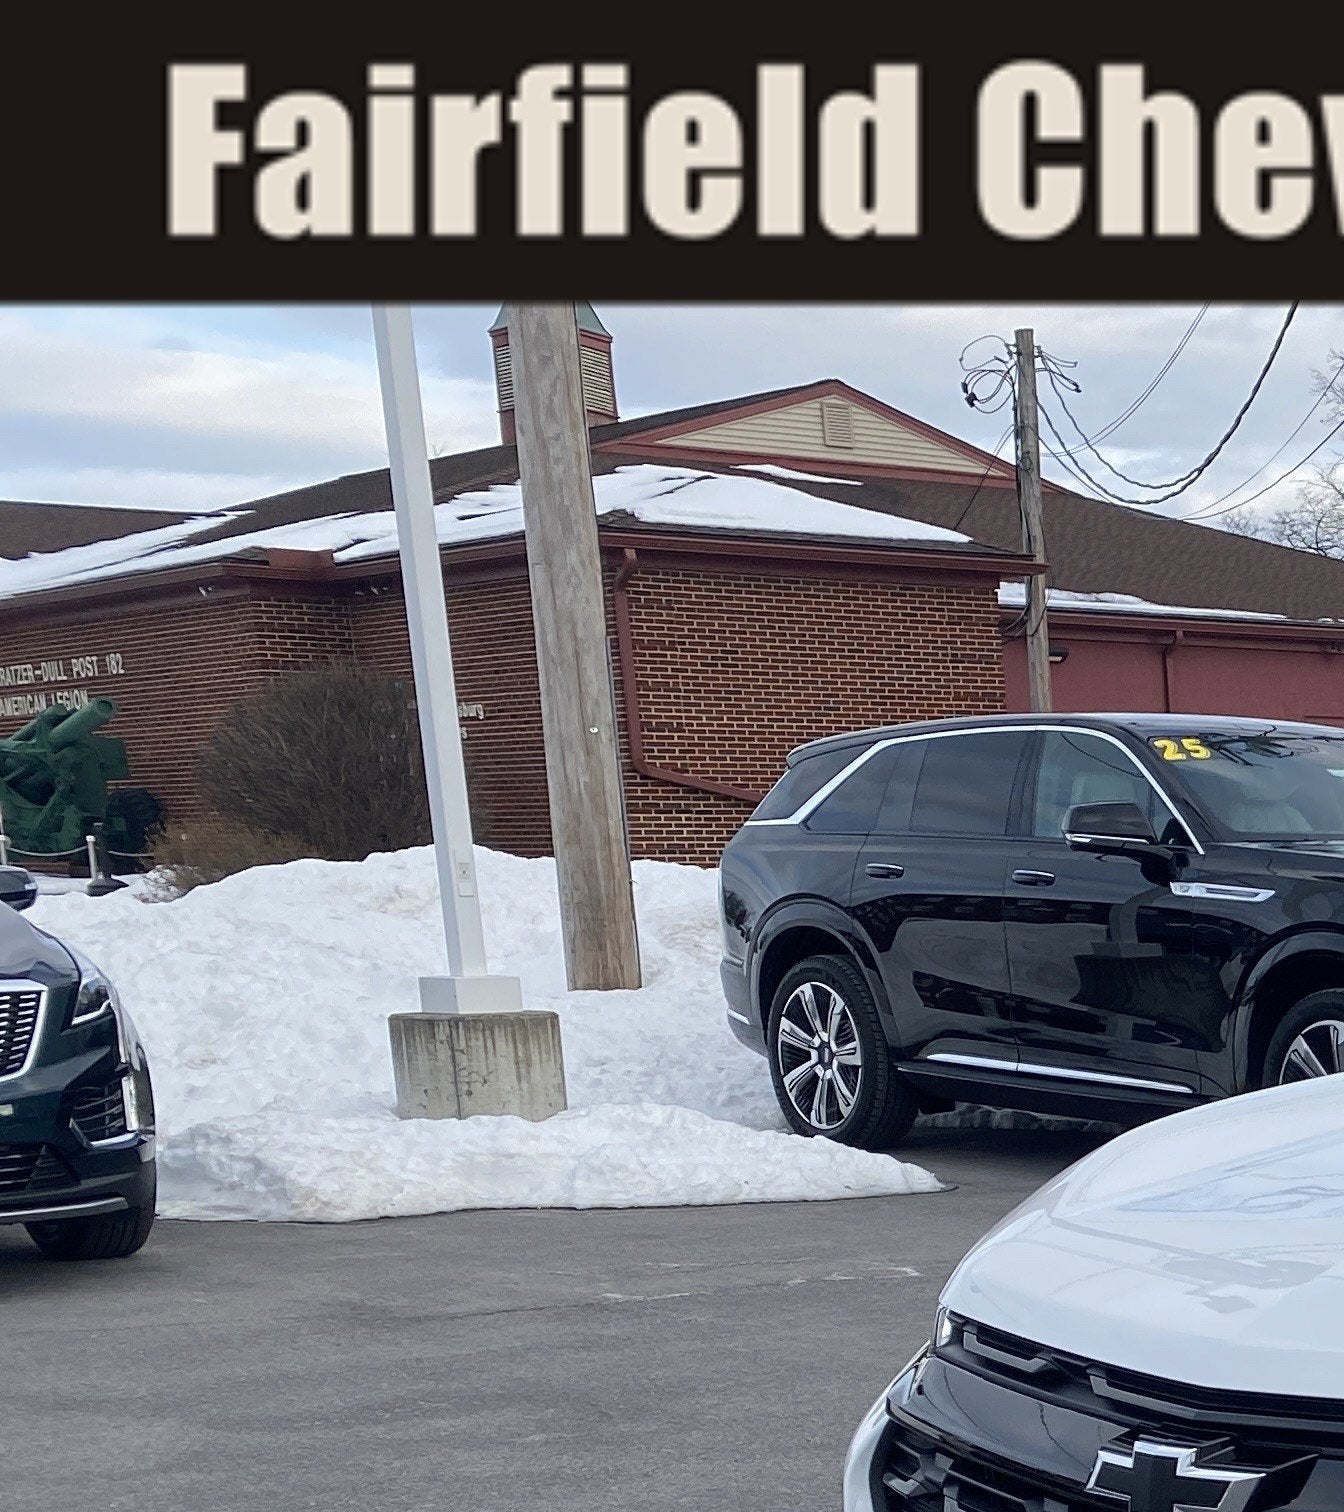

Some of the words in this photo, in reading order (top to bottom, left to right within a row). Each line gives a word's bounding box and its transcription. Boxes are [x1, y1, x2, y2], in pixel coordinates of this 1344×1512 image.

[71, 656, 98, 679] POST
[105, 653, 125, 674] 182
[1153, 738, 1212, 761] 25
